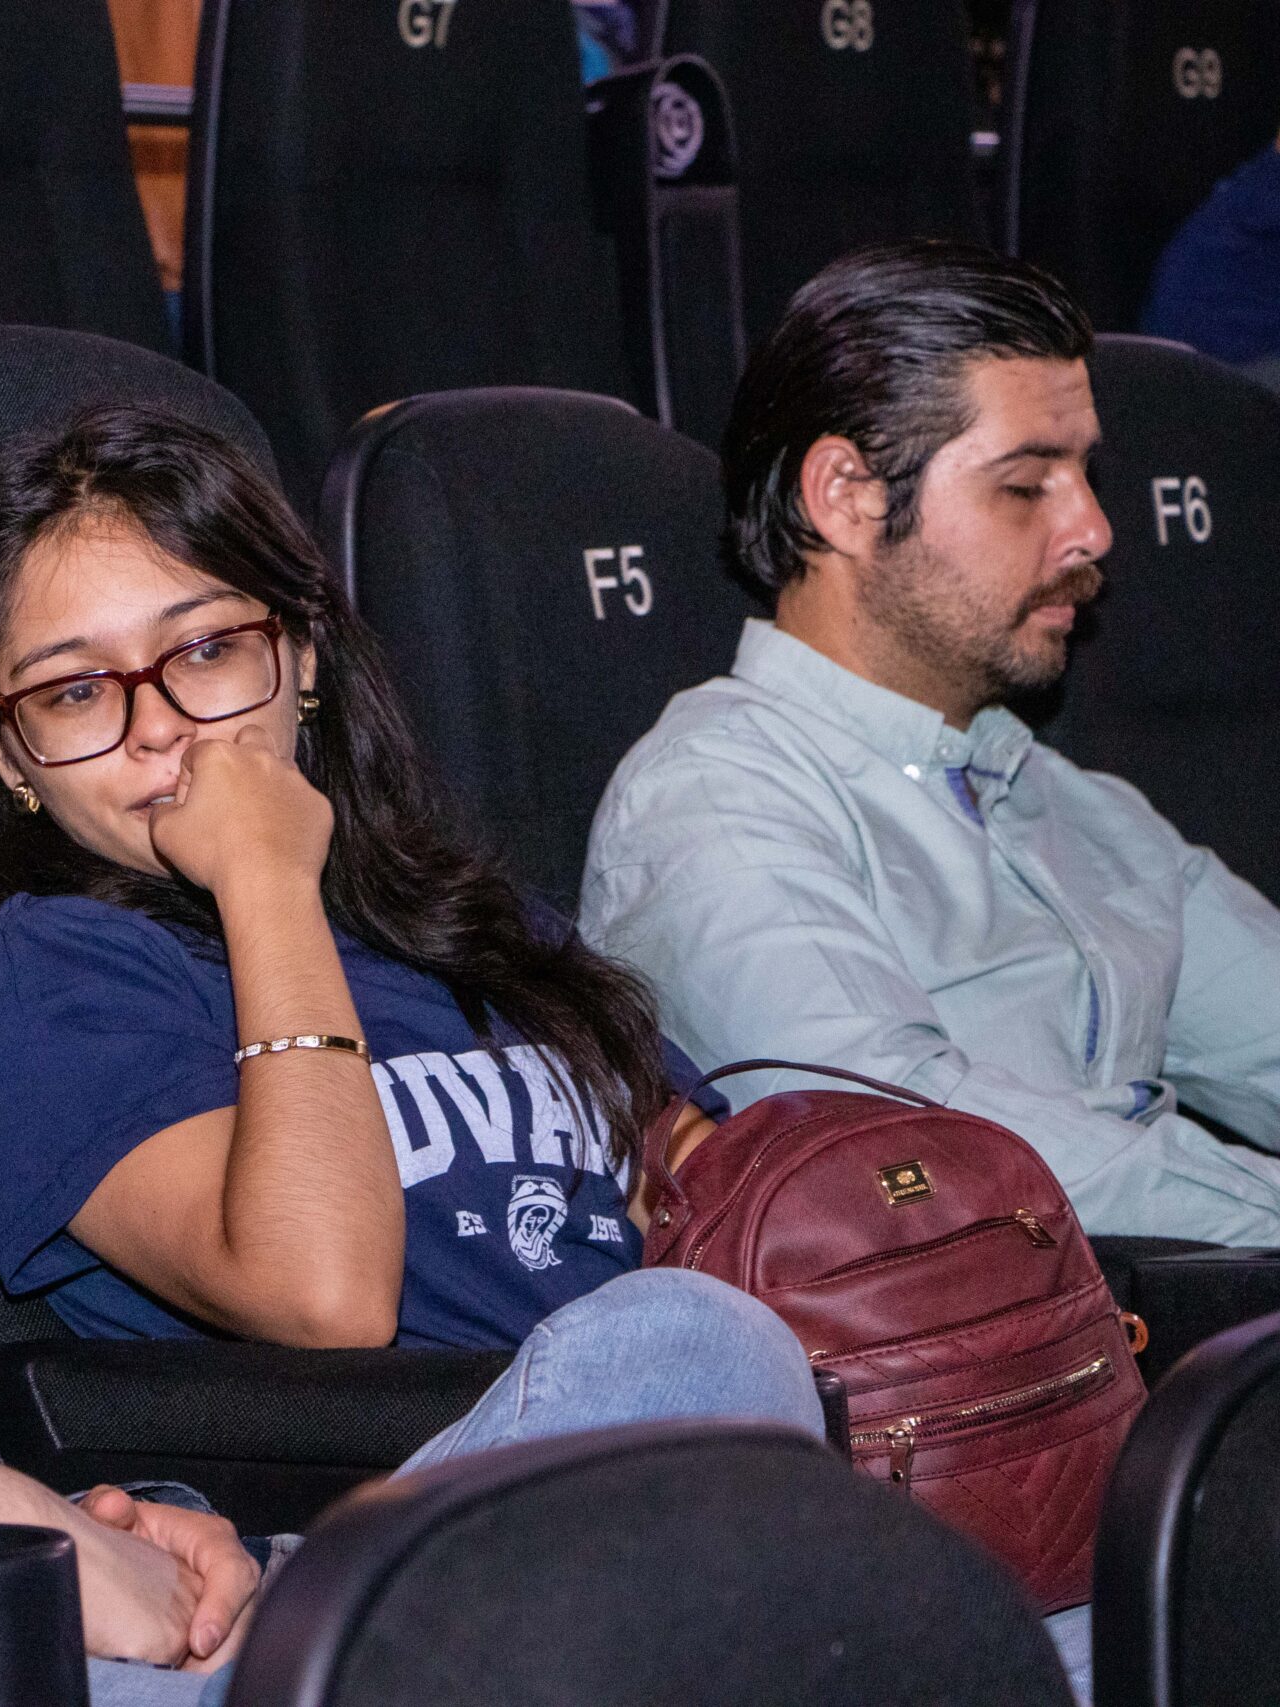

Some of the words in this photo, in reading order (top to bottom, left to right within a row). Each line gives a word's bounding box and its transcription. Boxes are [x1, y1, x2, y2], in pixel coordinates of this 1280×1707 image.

[398, 0, 457, 48] G7
[821, 0, 874, 51] G8
[1172, 47, 1222, 98] G9
[1152, 475, 1211, 545] F6
[583, 545, 652, 619] F5
